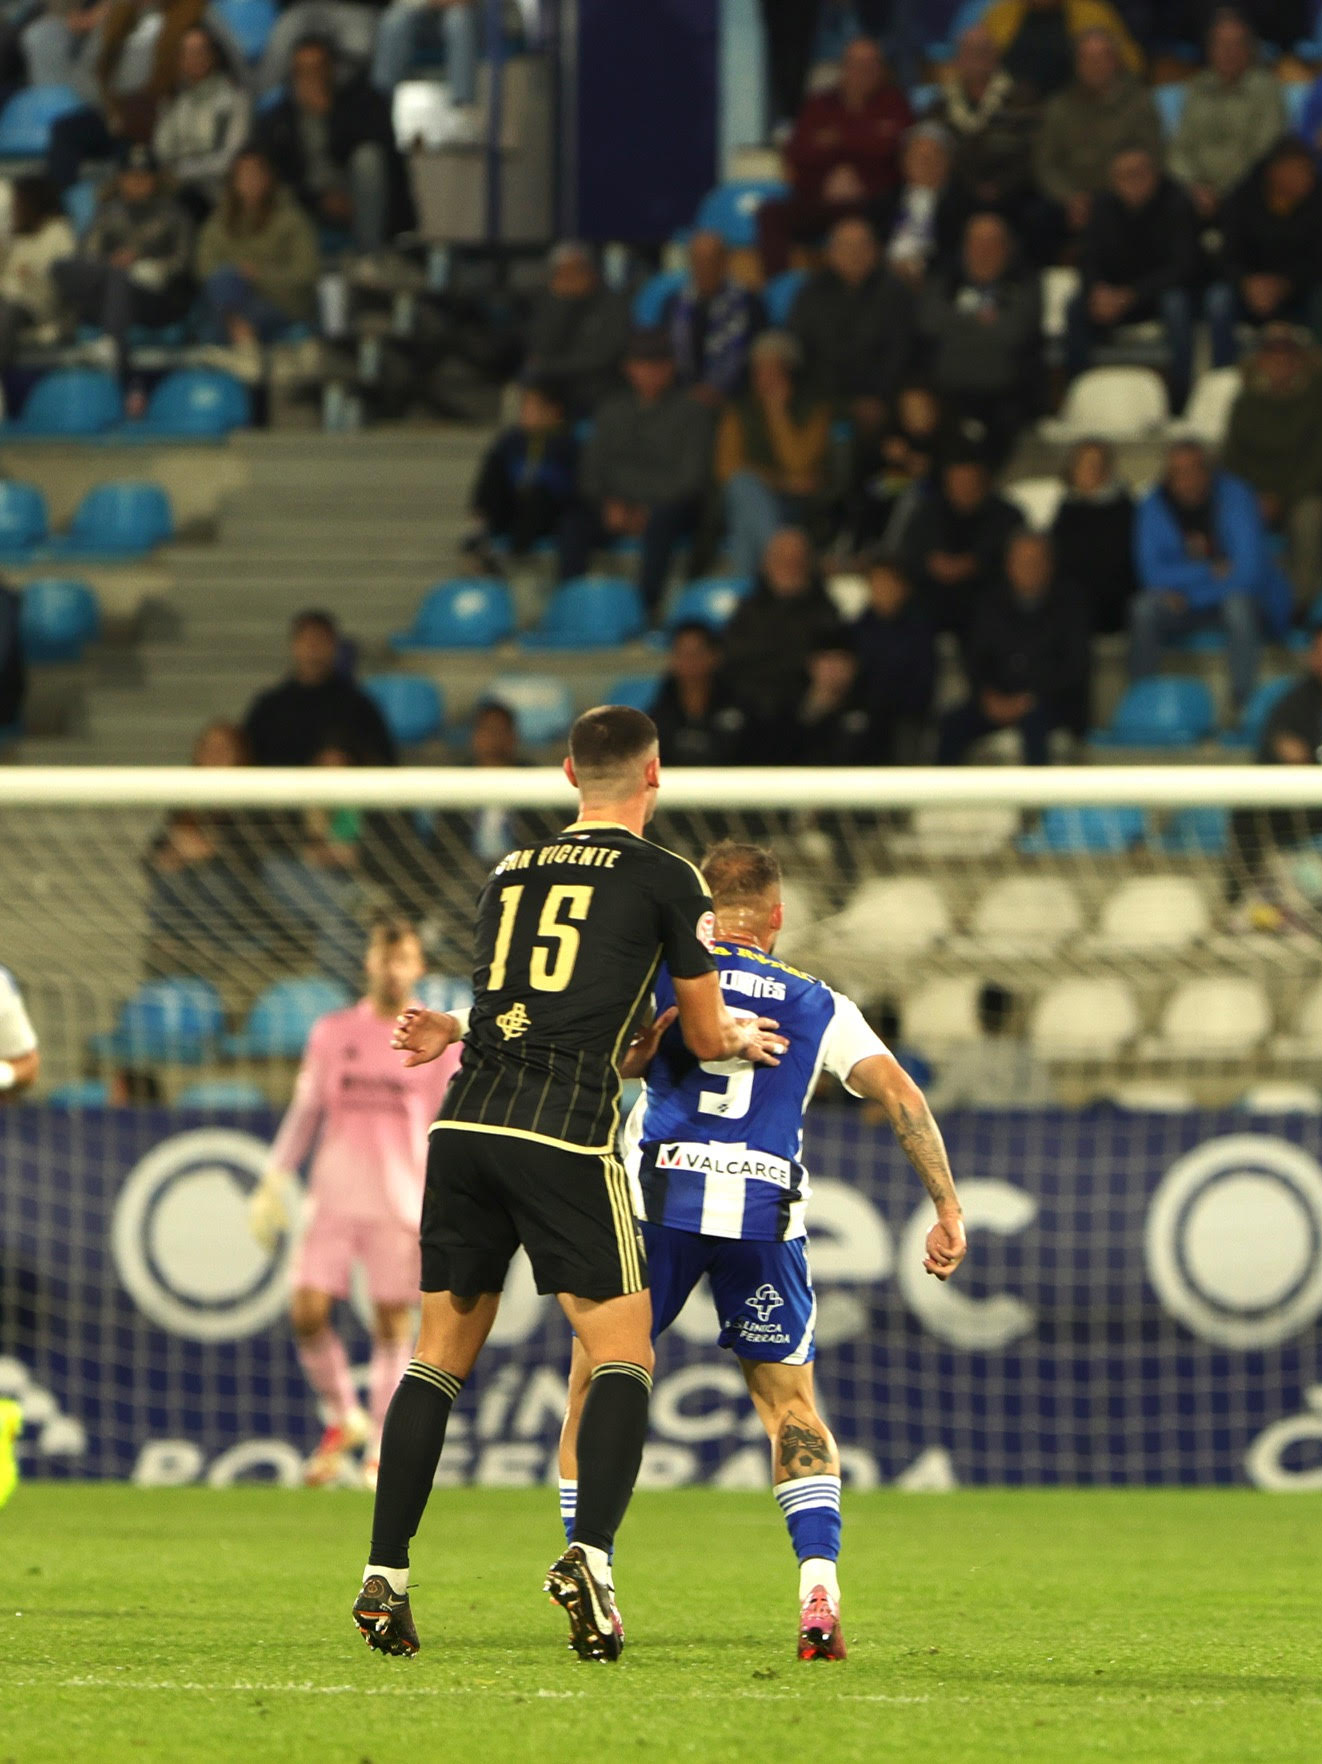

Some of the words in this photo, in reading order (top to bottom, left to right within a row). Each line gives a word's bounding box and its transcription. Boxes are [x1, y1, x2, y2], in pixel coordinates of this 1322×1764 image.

[537, 844, 622, 868] VICENTE
[487, 884, 595, 993] 15
[686, 1153, 787, 1184] VALCARCE
